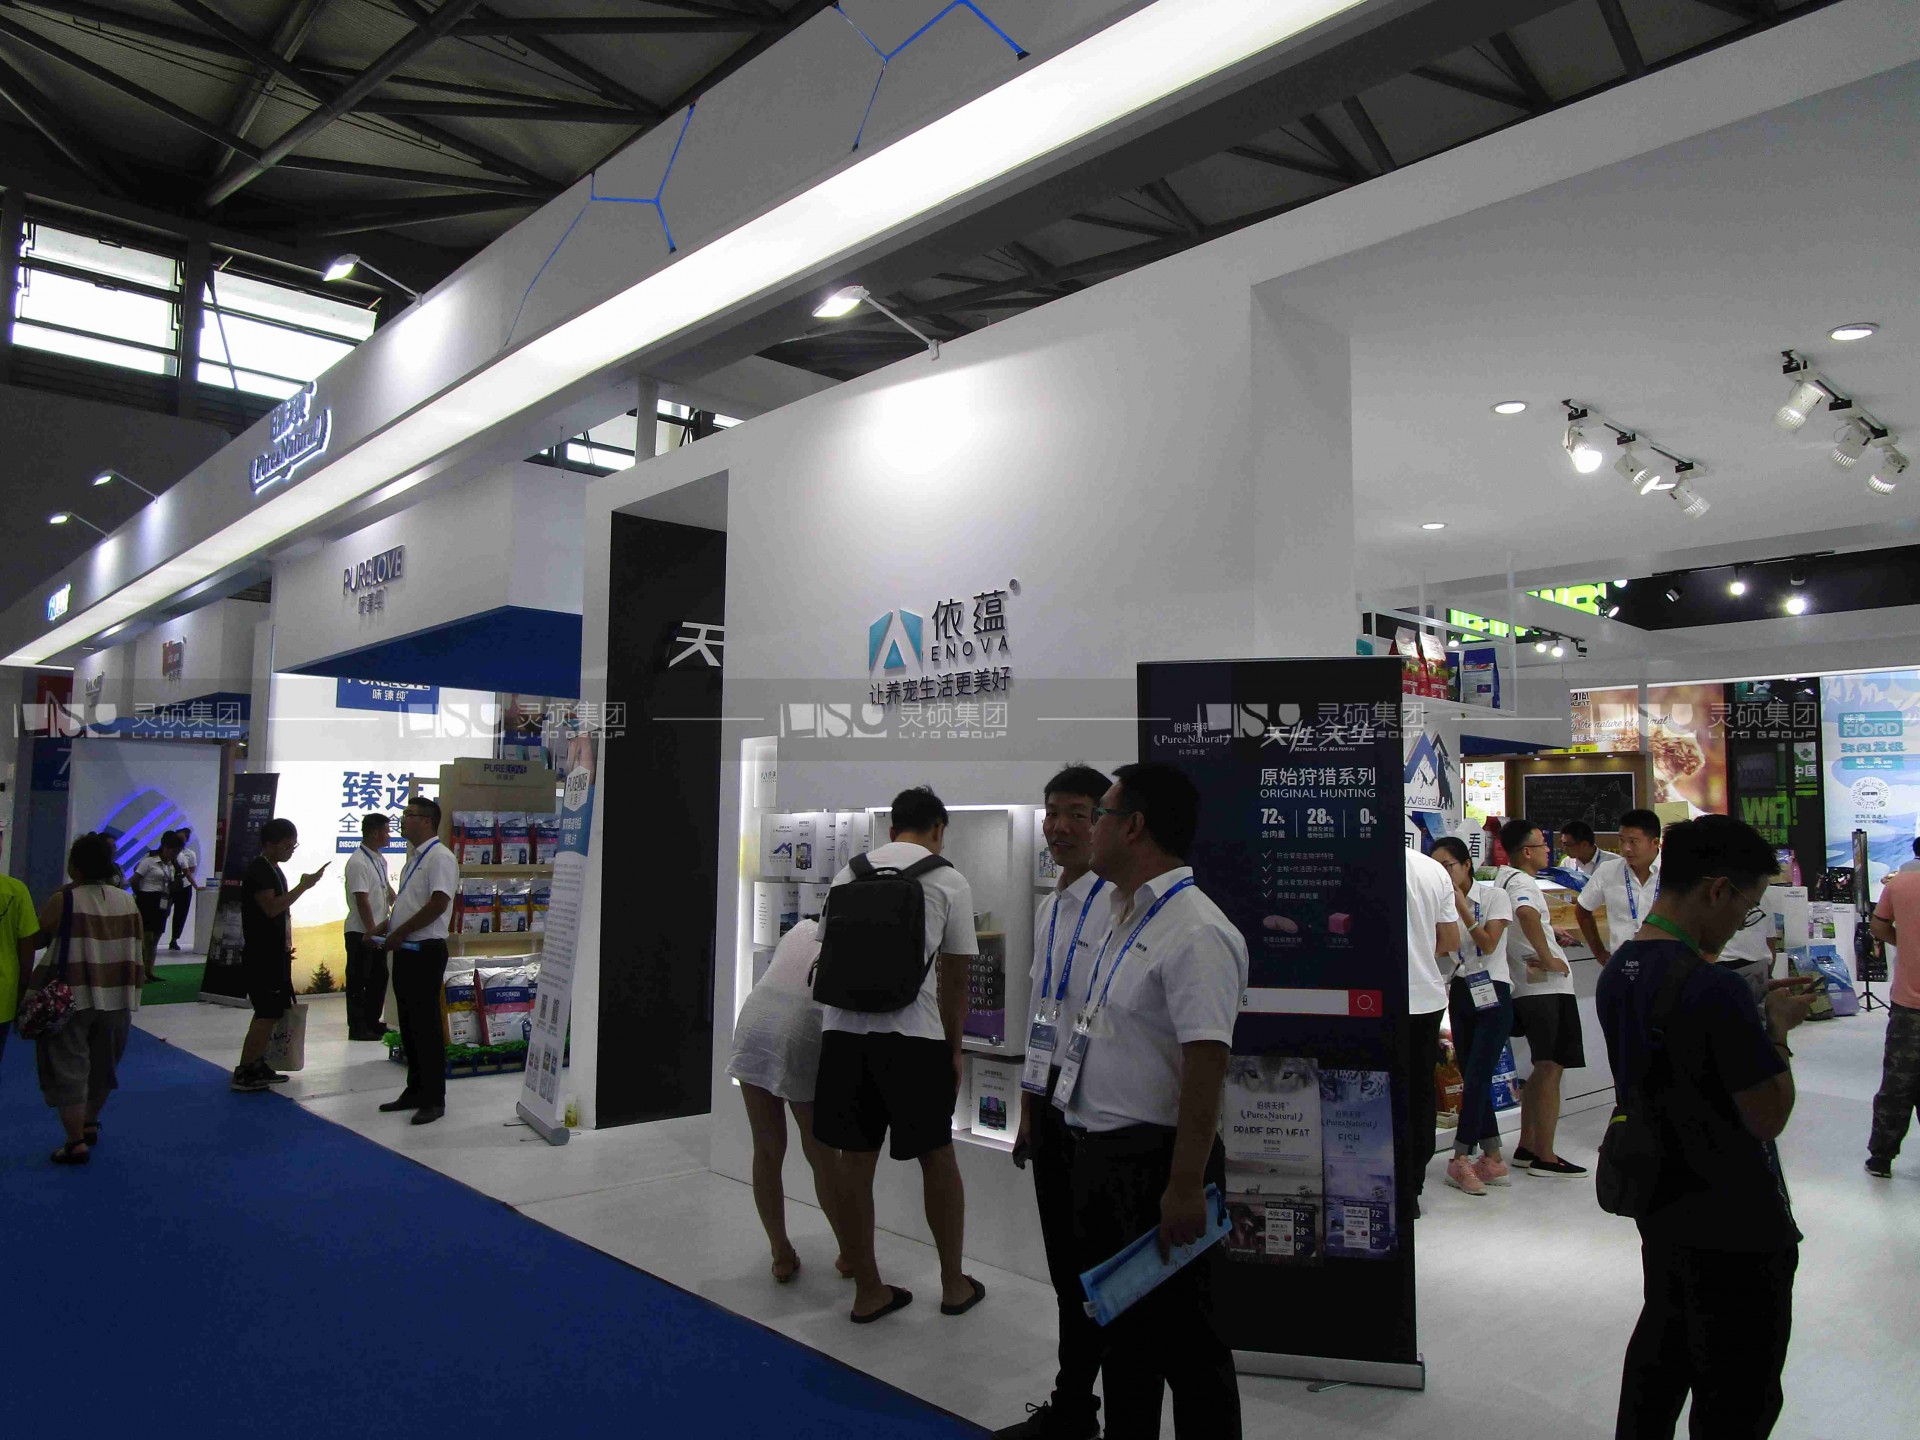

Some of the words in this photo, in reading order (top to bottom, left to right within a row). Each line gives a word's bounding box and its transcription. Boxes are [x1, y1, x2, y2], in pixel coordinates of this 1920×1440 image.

[931, 590, 1007, 641] 依蕴
[667, 621, 724, 668] 天
[931, 635, 1009, 662] ENOVA
[868, 665, 1011, 705] 让养宠生活更美好
[1260, 719, 1376, 753] 天性天生
[1843, 723, 1900, 737] FJORD
[1260, 766, 1376, 786] 原始狩猎系列
[1260, 788, 1317, 798] ORIGINAL
[1320, 788, 1376, 798] HUNTING
[1260, 808, 1286, 825] 72%
[1307, 808, 1335, 825] 28%
[1360, 807, 1378, 825] 0%
[1261, 830, 1286, 839] 含肉量
[1469, 833, 1482, 858] 看
